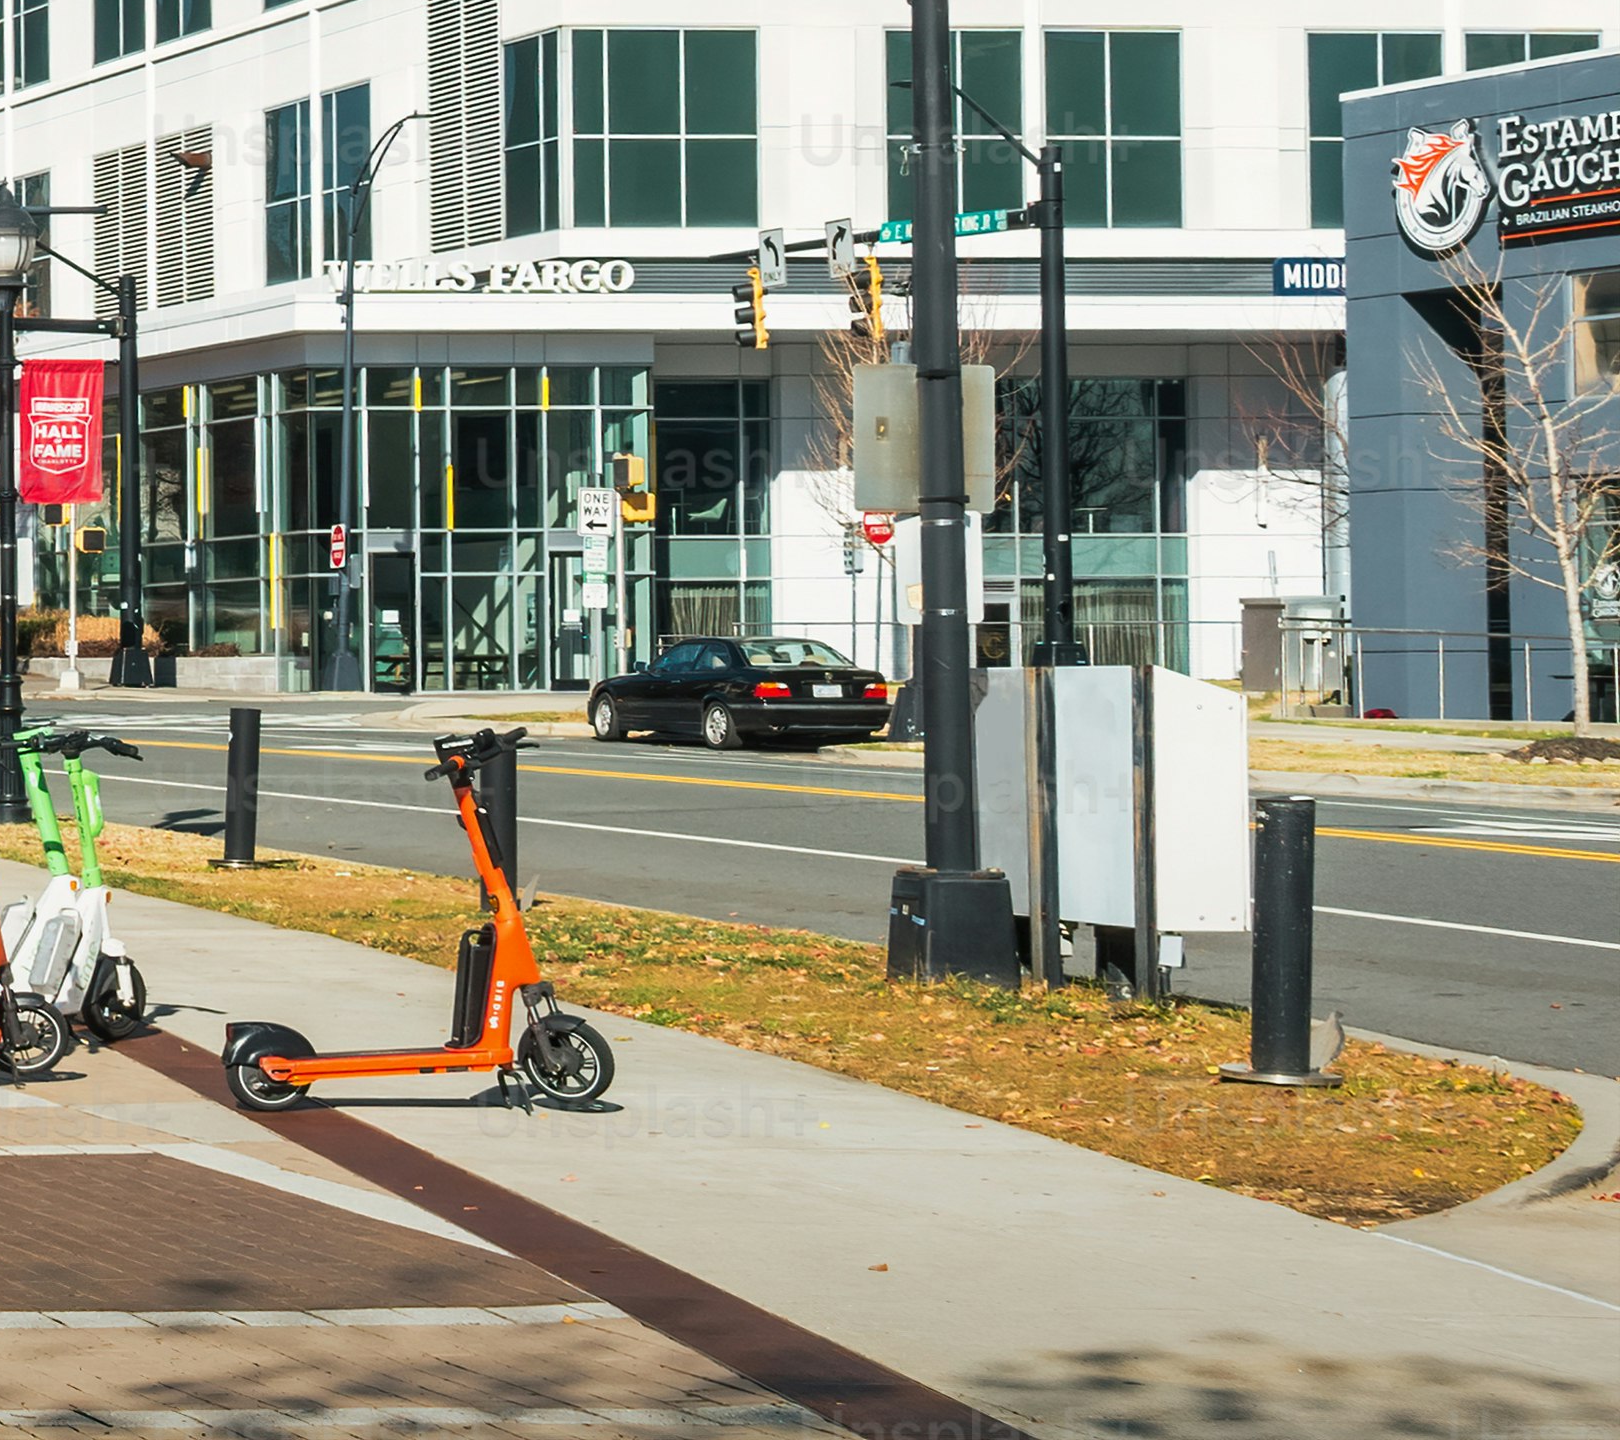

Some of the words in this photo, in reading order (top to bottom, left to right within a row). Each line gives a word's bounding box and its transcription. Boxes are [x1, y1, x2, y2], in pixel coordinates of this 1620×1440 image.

[1515, 206, 1570, 225] BRAZILIAN
[323, 260, 476, 293] WELLS
[483, 260, 635, 293] FARGO
[34, 424, 83, 439] HALL
[33, 444, 83, 459] FAME
[584, 493, 610, 504] ONE
[583, 506, 610, 517] WAY
[493, 980, 505, 1011] BIRD
